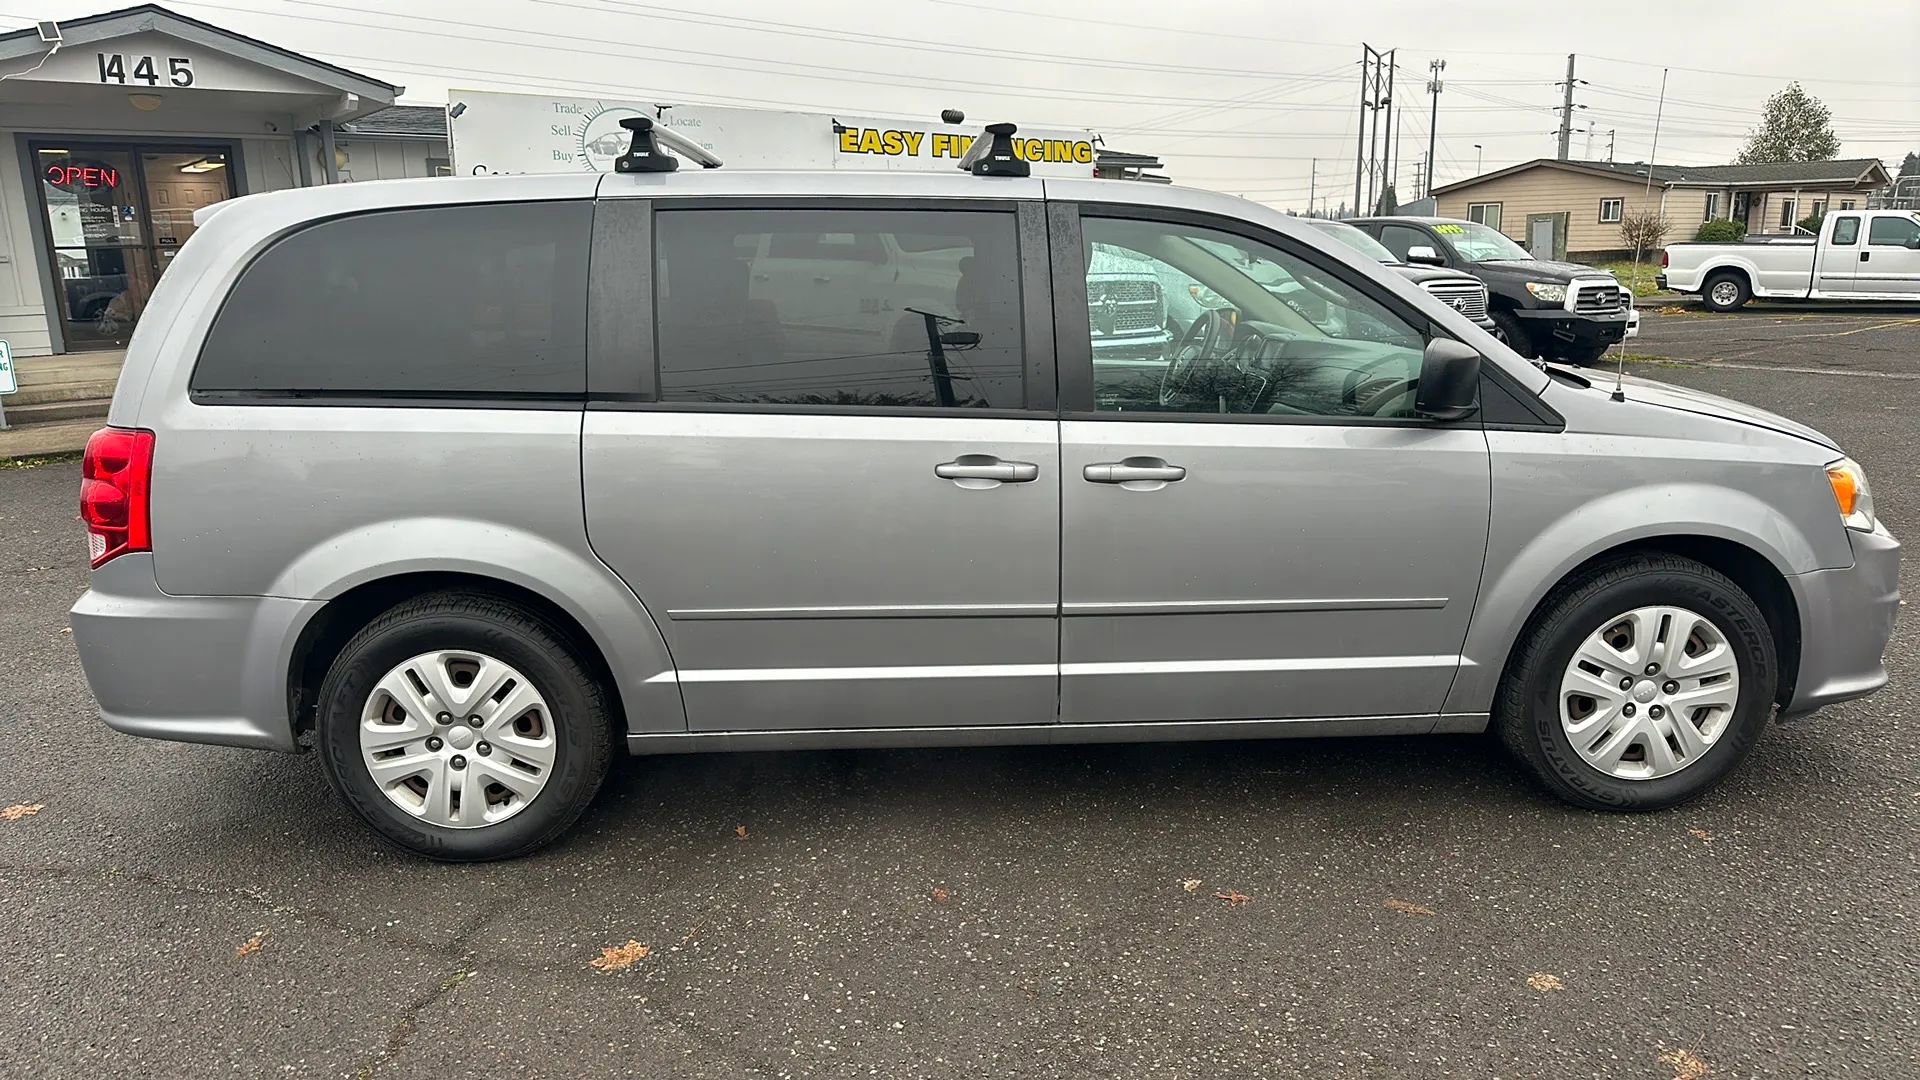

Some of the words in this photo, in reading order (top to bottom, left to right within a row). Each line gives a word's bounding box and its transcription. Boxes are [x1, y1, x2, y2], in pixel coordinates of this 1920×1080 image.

[97, 53, 194, 87] 1445
[552, 102, 583, 114] Trade
[669, 115, 702, 127] Locate
[551, 125, 571, 136] Sell
[839, 127, 925, 157] EASY
[932, 132, 1092, 164] FINNCING
[552, 150, 574, 164] Buy
[48, 166, 117, 188] OPEN
